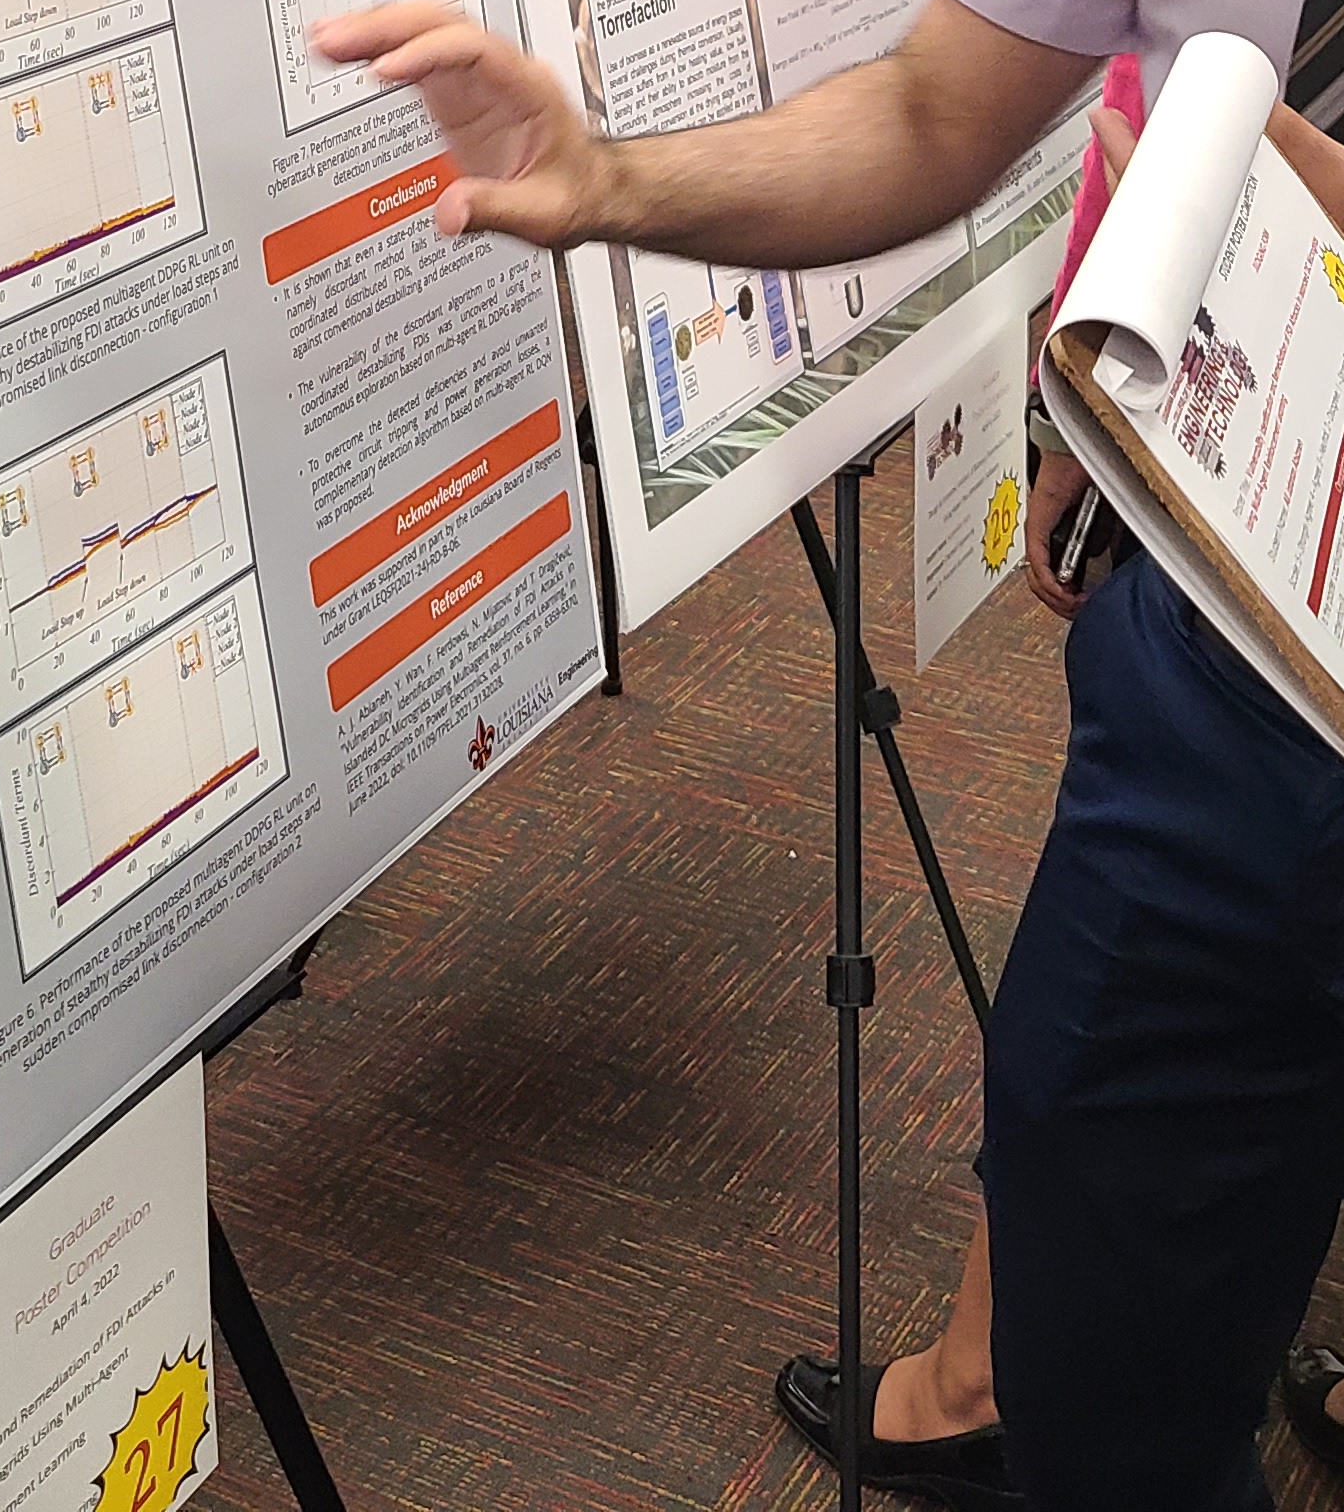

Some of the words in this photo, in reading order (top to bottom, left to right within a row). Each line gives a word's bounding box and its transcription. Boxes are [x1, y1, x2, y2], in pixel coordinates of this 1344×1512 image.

[369, 174, 437, 218] Conclusions
[16, 331, 29, 349] of
[28, 324, 49, 344] the
[51, 302, 101, 339] proposed
[1178, 354, 1222, 457] ENGINEERING
[1203, 340, 1249, 450] TECHNOLOGY
[395, 459, 489, 535] Acknowledgment
[991, 494, 1010, 550] 26
[430, 569, 483, 618] Reference
[496, 686, 554, 744] LOUISIANA
[558, 645, 598, 686] Engineering
[49, 1194, 116, 1261] Graduate
[15, 1282, 63, 1334] Poster
[66, 1200, 151, 1287] Competition
[52, 1302, 79, 1335] April
[92, 1264, 120, 1297] 2022
[125, 1282, 164, 1323] Attacks
[162, 1268, 176, 1287] in
[124, 1391, 184, 1512] 27
